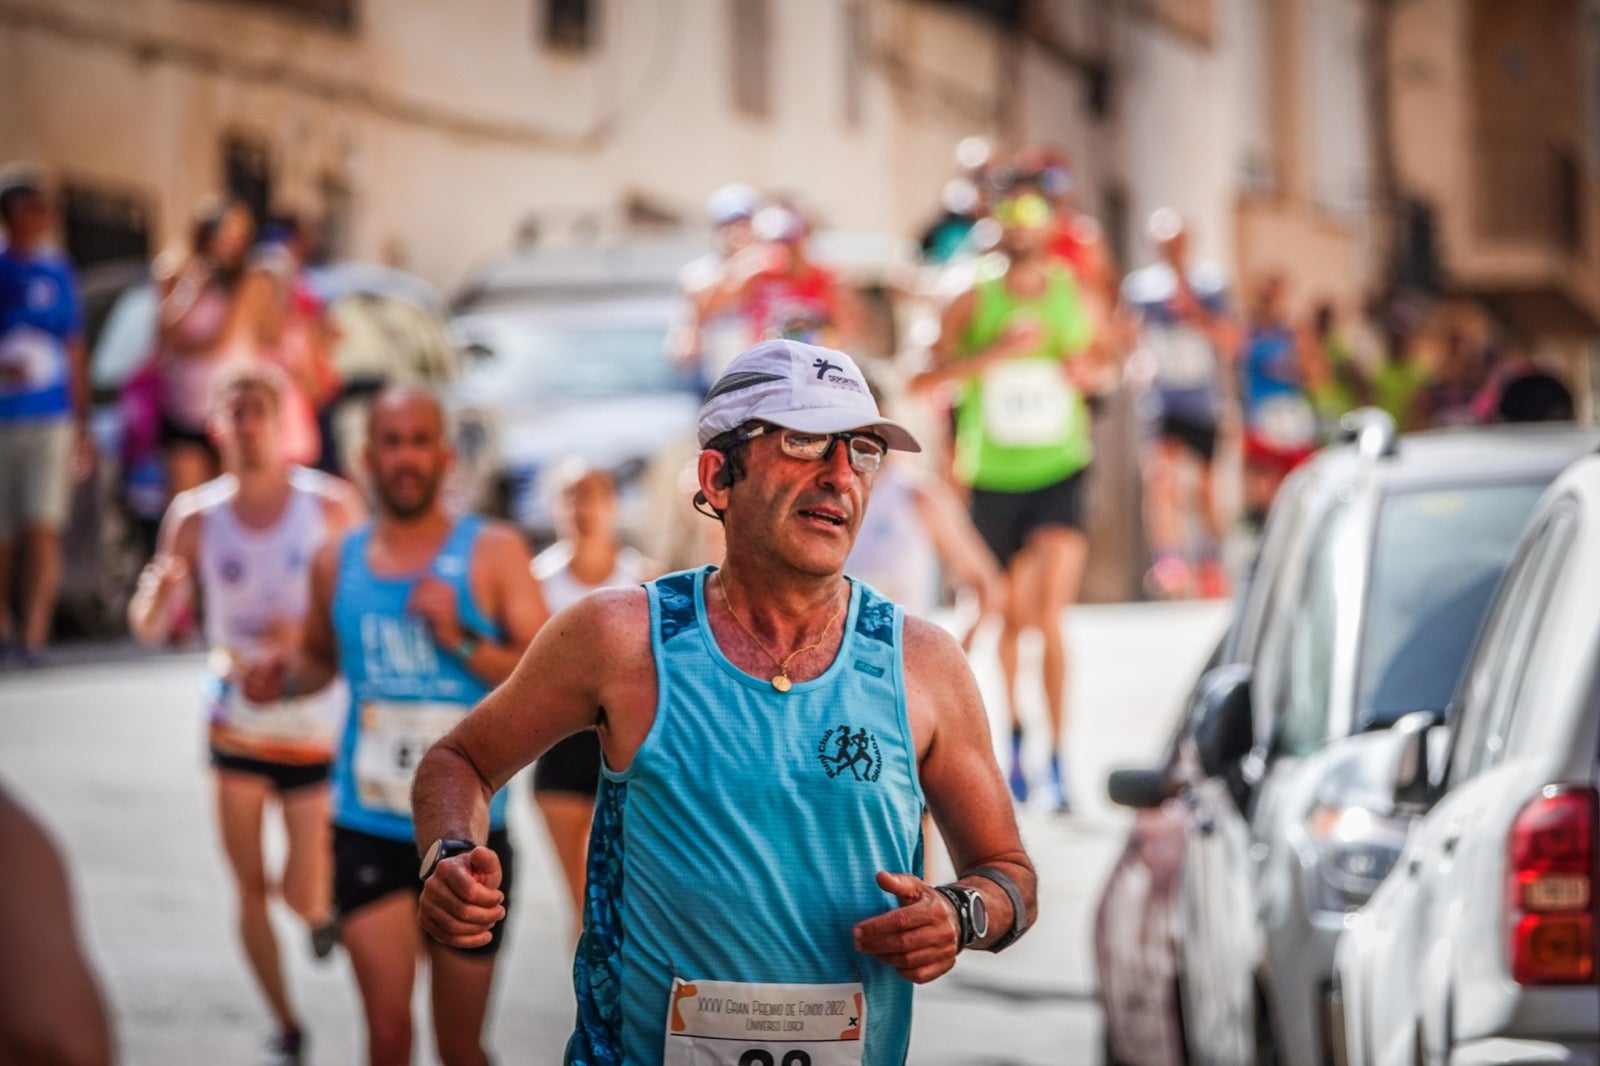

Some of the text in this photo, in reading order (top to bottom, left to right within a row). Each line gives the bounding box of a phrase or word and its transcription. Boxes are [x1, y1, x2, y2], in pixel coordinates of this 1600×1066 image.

[870, 734, 883, 782] GRANADA
[698, 996, 722, 1012] XXXV
[725, 998, 749, 1015] GRAN
[799, 1001, 823, 1016] FONDO
[825, 1000, 846, 1016] 2022
[746, 1017, 804, 1032] UNIVERSO LORCA
